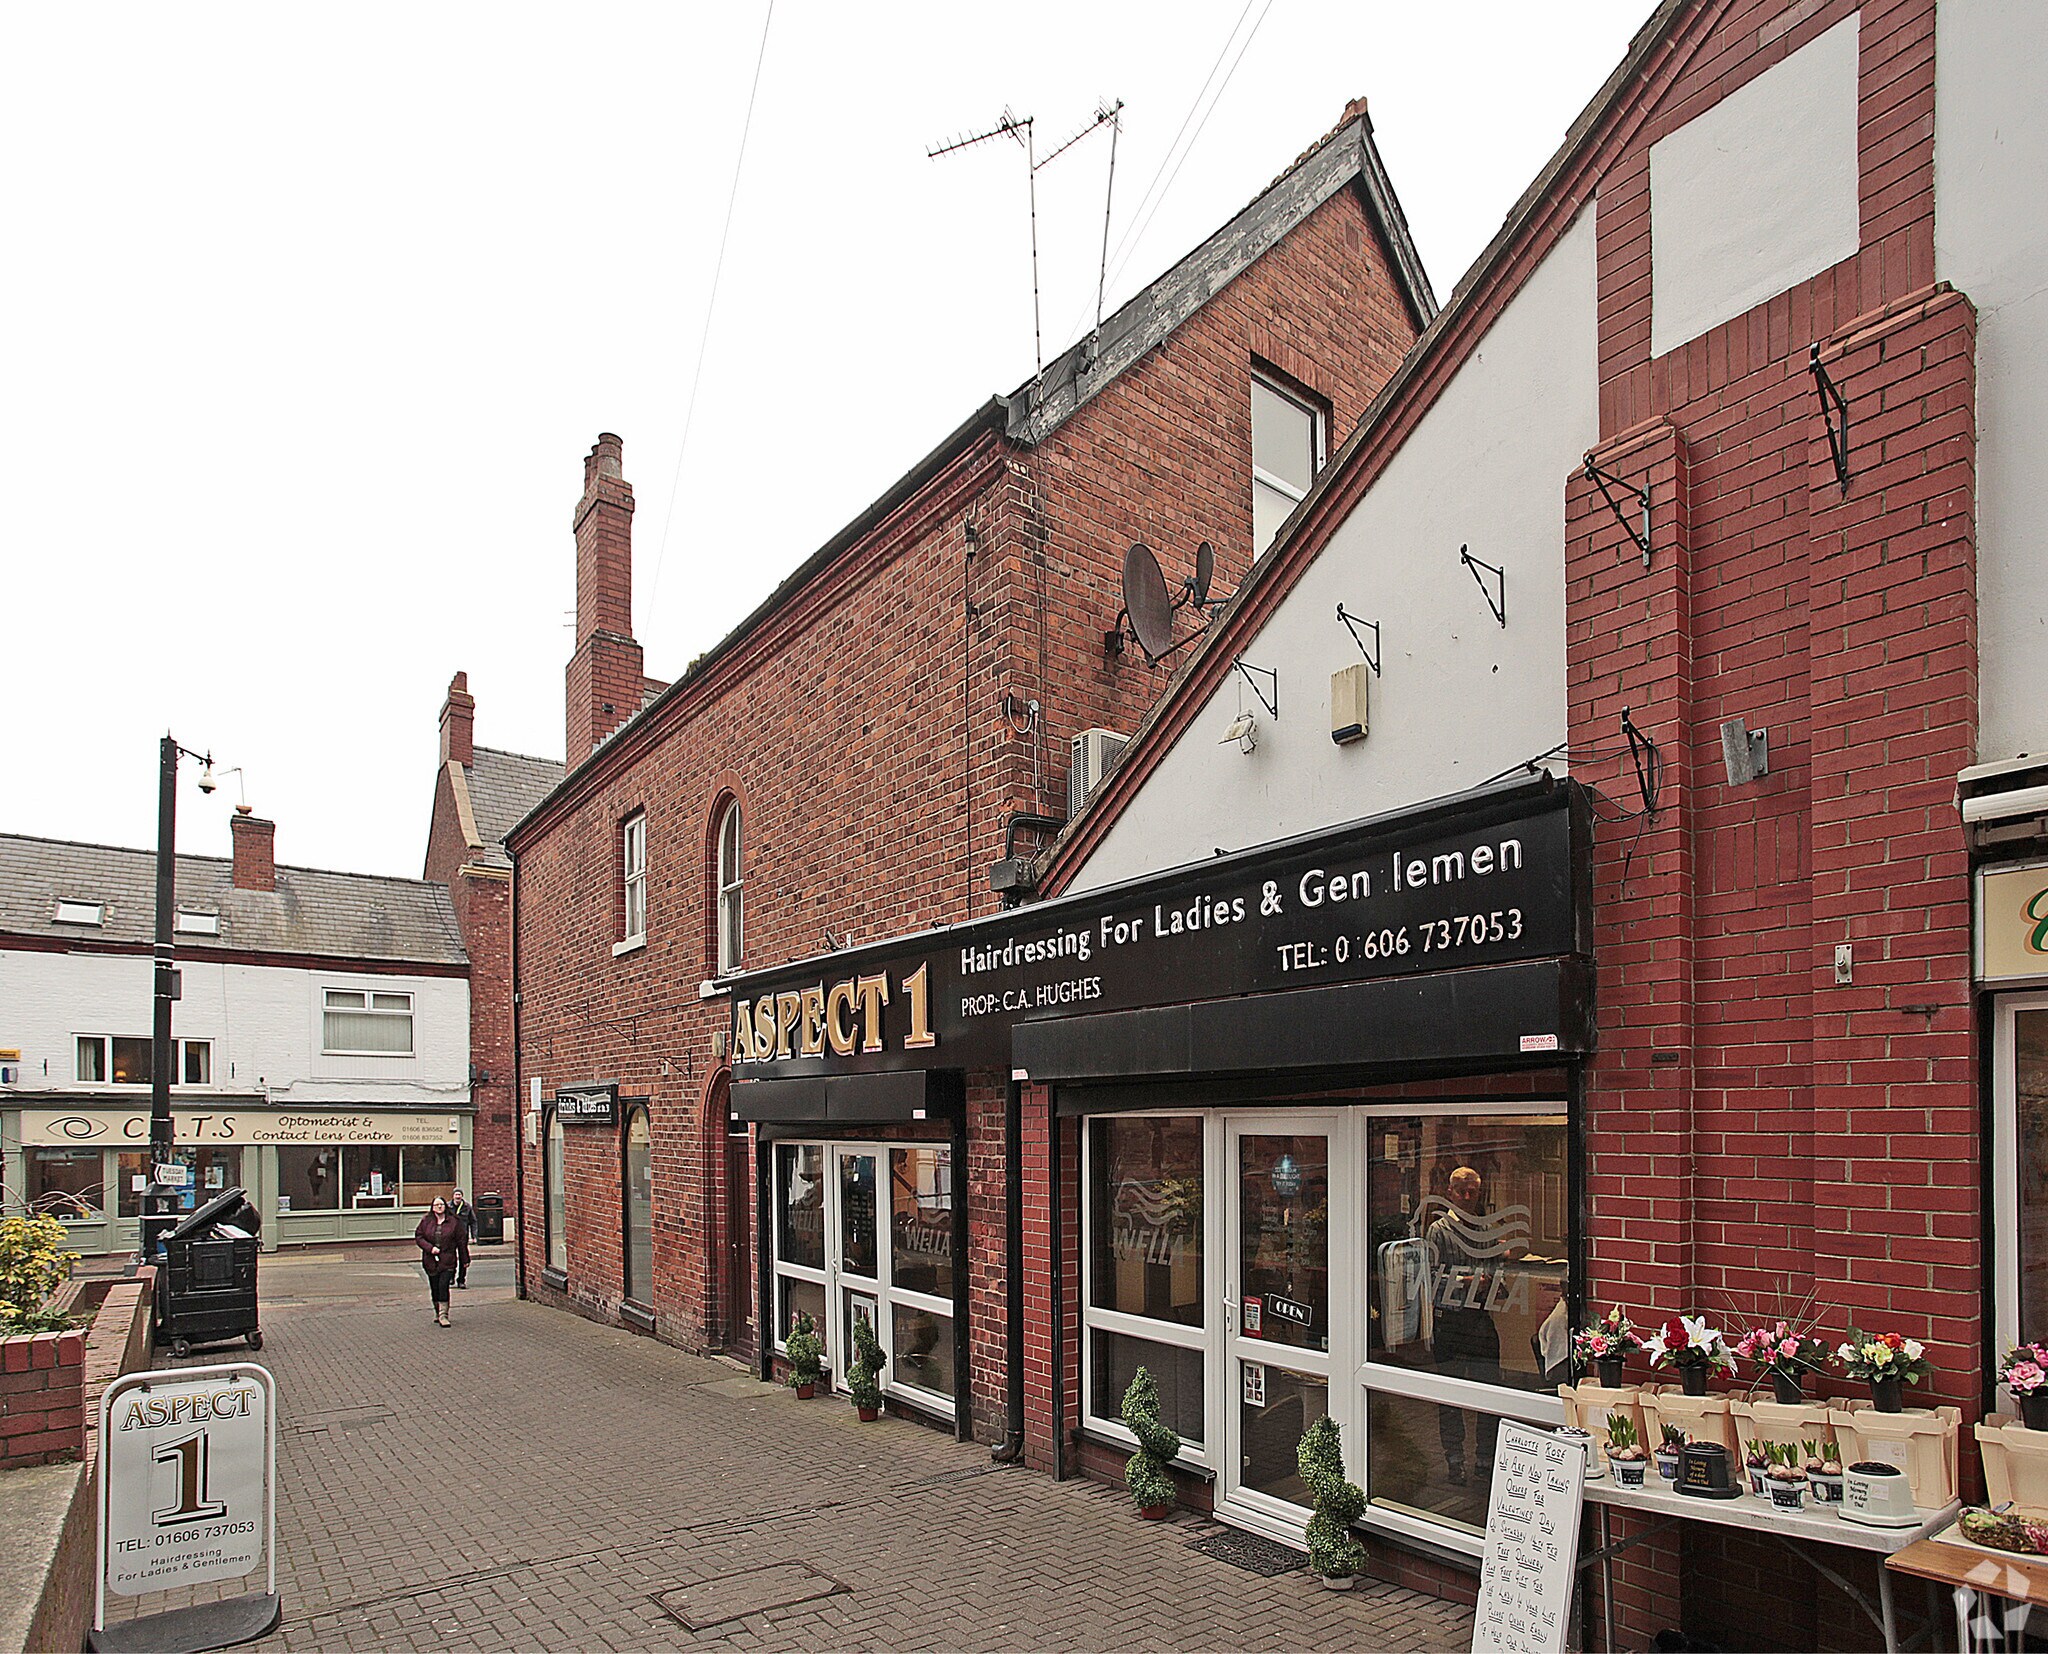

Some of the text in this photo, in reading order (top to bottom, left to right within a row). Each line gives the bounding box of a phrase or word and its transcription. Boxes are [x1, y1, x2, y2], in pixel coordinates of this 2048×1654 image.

[961, 928, 1091, 975] Hairdressing
[1100, 914, 1143, 949] For
[1155, 895, 1246, 938] Ladies
[1260, 880, 1283, 916] &
[1277, 942, 1328, 971] TEL:
[1419, 908, 1523, 952] 737053
[1037, 976, 1102, 1007] HUGHES
[732, 960, 936, 1064] ASPECT 1
[252, 1130, 393, 1140] Contact Lens Centre
[278, 1116, 373, 1129] Optometrist &
[162, 1167, 184, 1175] TUESDAY
[163, 1175, 183, 1183] MARKET
[906, 1226, 952, 1257] WELLA
[1113, 1228, 1184, 1267] WELLA
[1406, 1263, 1530, 1316] WELLA
[1276, 1300, 1305, 1320] OPEN
[120, 1387, 256, 1431] ASPECT
[152, 1427, 227, 1528] 1
[116, 1521, 255, 1553] TEL: 01606 737053
[117, 1553, 251, 1582] For Ladies & Gentlemen
[150, 1548, 222, 1566] Hairdressing
